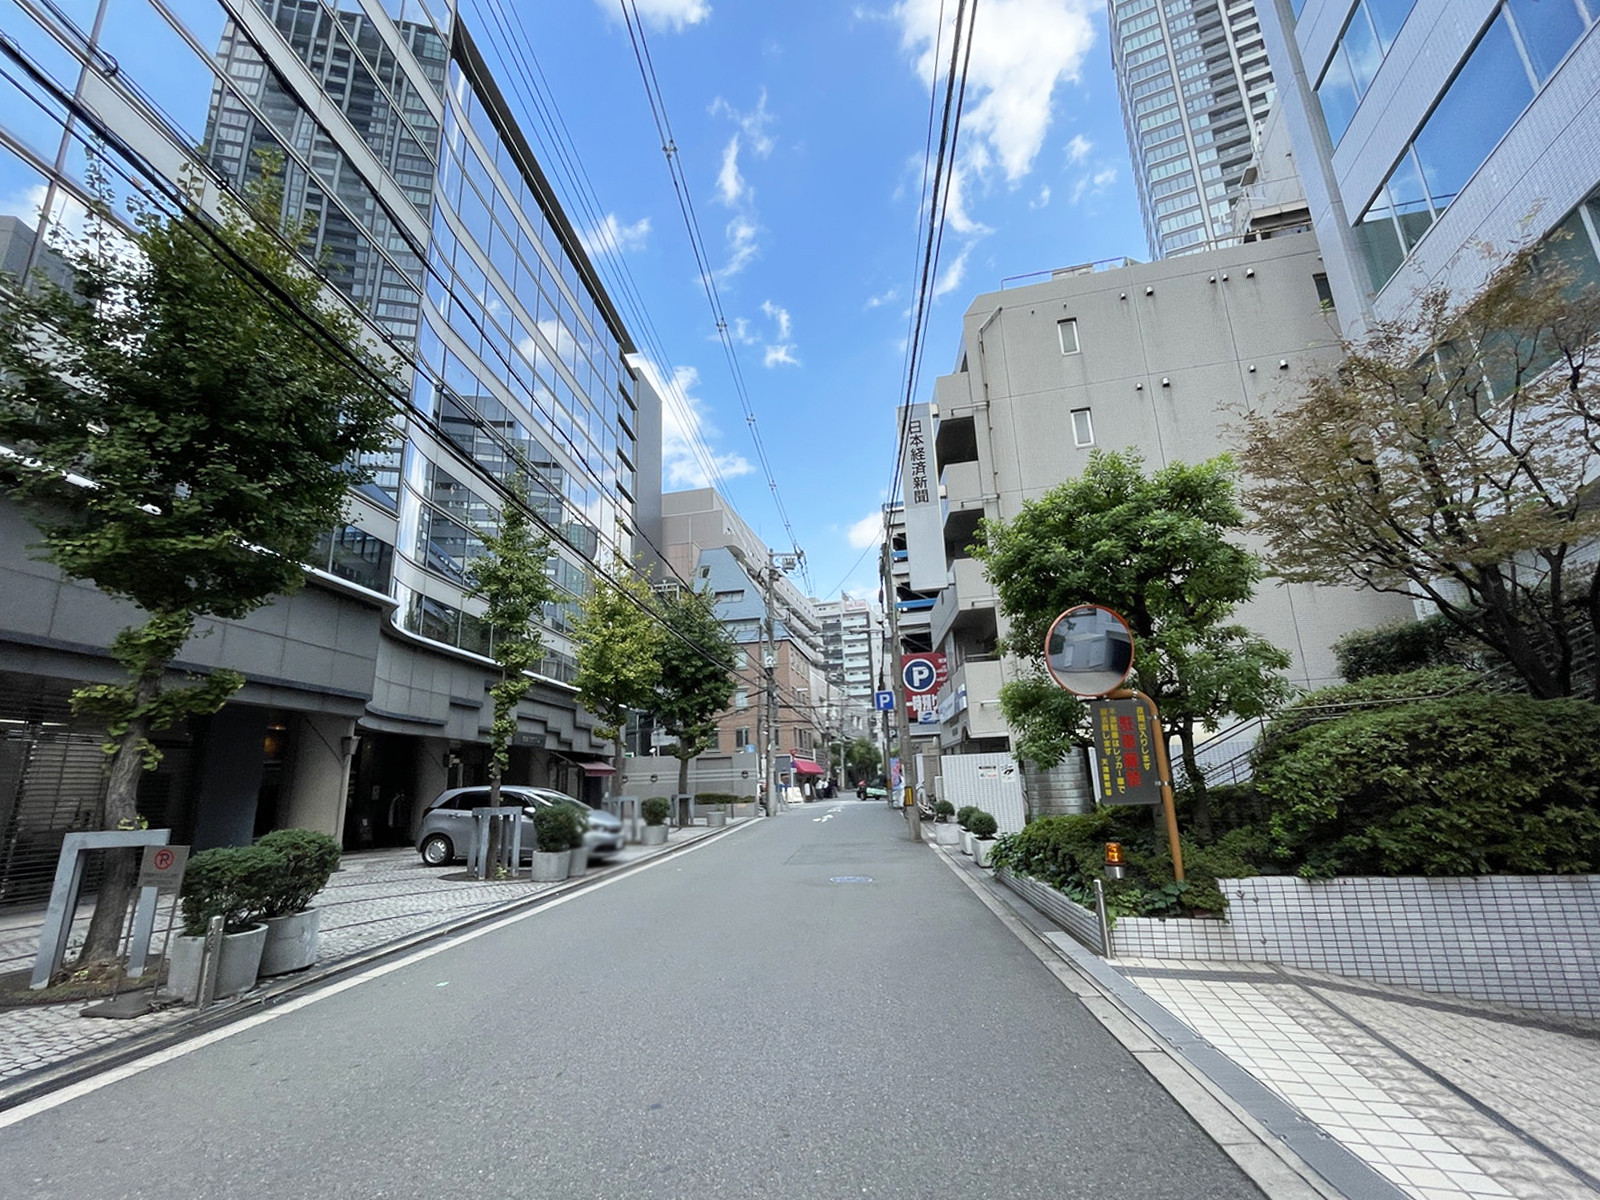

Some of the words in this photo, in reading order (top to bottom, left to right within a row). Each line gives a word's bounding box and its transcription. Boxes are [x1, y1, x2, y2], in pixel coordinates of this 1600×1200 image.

[909, 420, 929, 504] 日本経済新聞
[912, 666, 930, 687] P
[880, 693, 890, 708] P
